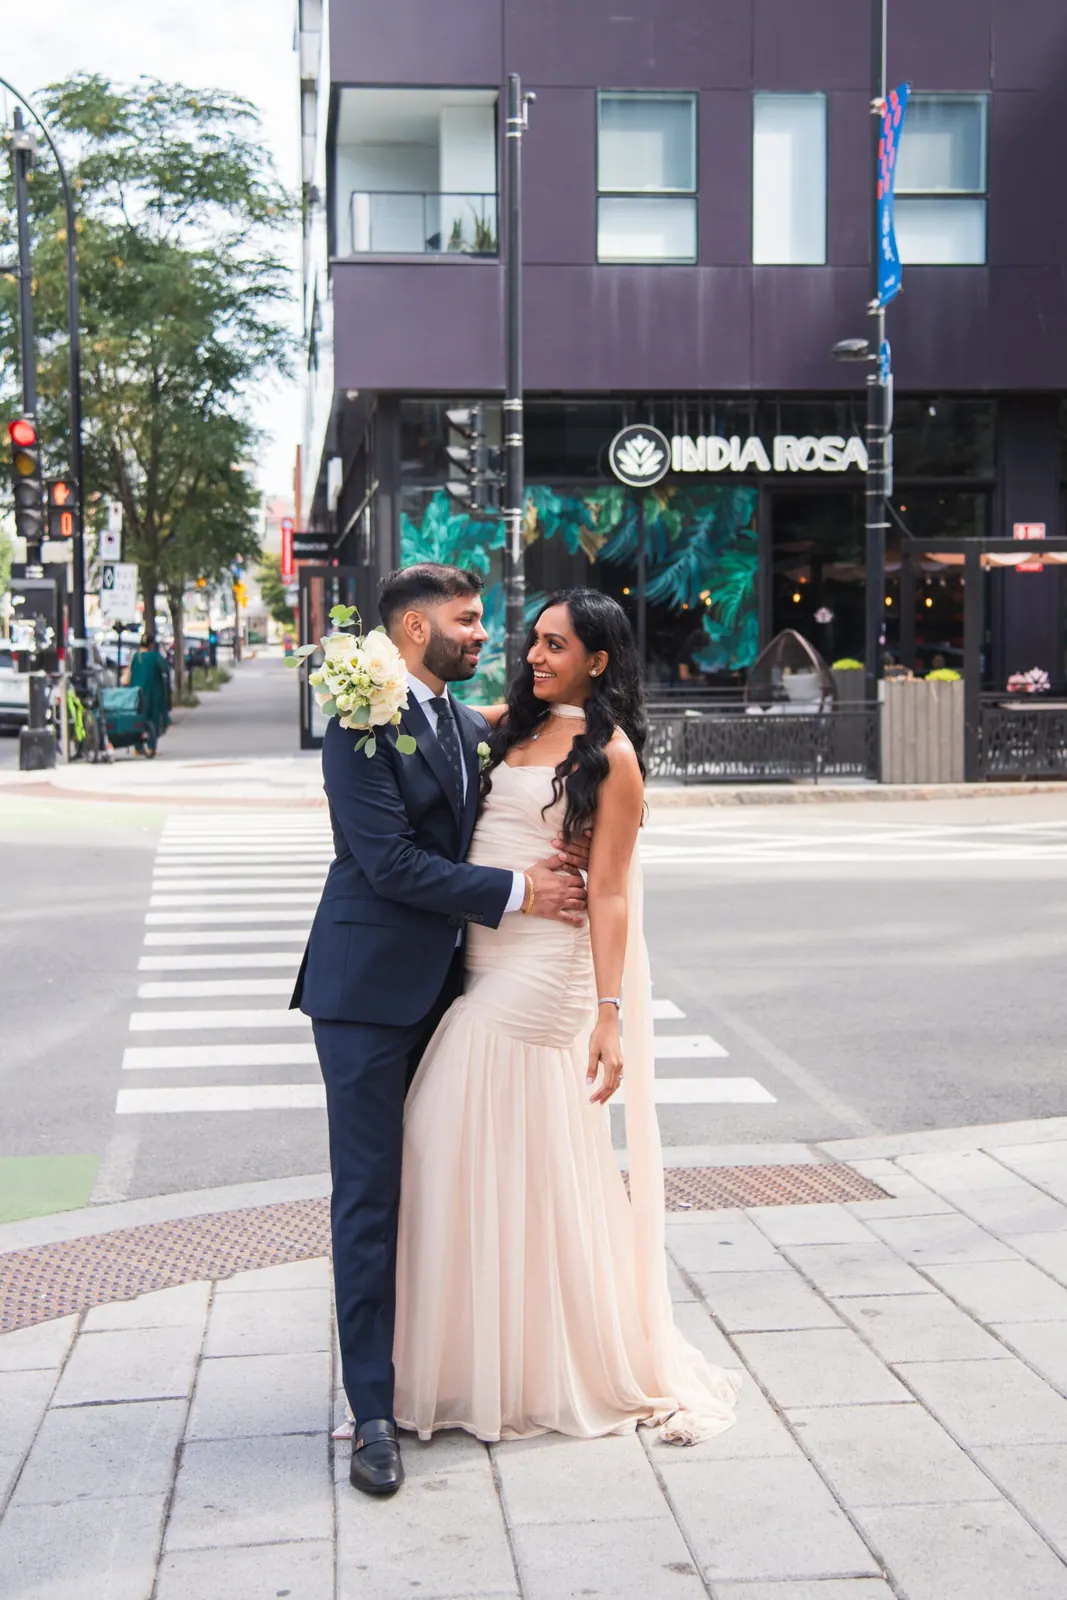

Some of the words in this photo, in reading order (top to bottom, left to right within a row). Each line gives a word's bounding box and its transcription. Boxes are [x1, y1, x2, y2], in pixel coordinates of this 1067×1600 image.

[671, 435, 771, 471] INDIA
[774, 435, 868, 471] ROSA
[61, 511, 72, 536] 0
